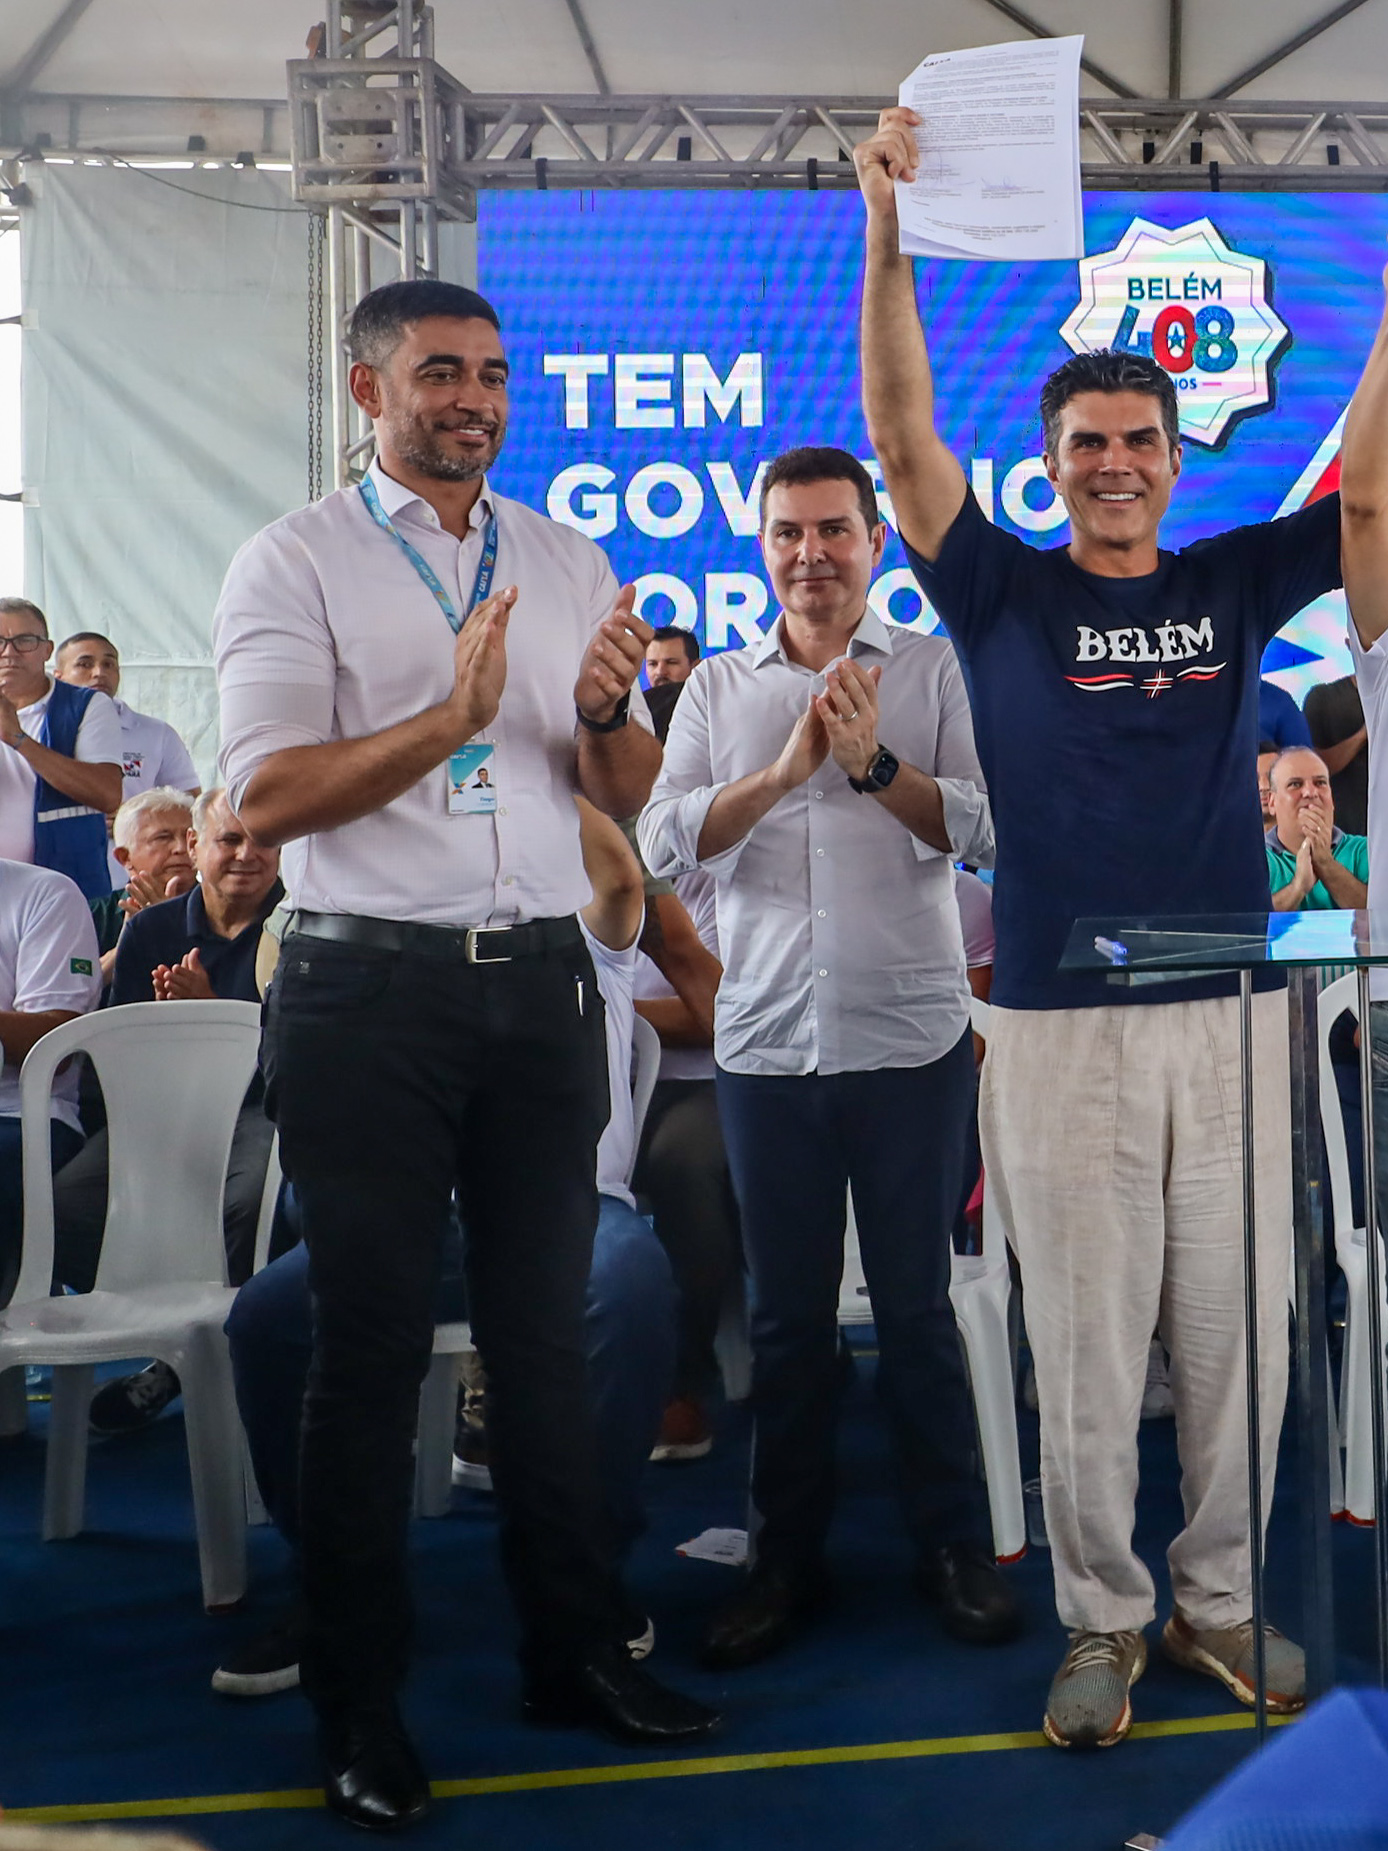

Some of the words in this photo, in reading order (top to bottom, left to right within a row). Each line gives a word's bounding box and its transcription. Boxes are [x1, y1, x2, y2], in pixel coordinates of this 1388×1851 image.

[1127, 272, 1222, 300] BELÉM
[1110, 304, 1239, 374] 408
[544, 352, 763, 429] TEM
[1075, 616, 1216, 663] BELÉM
